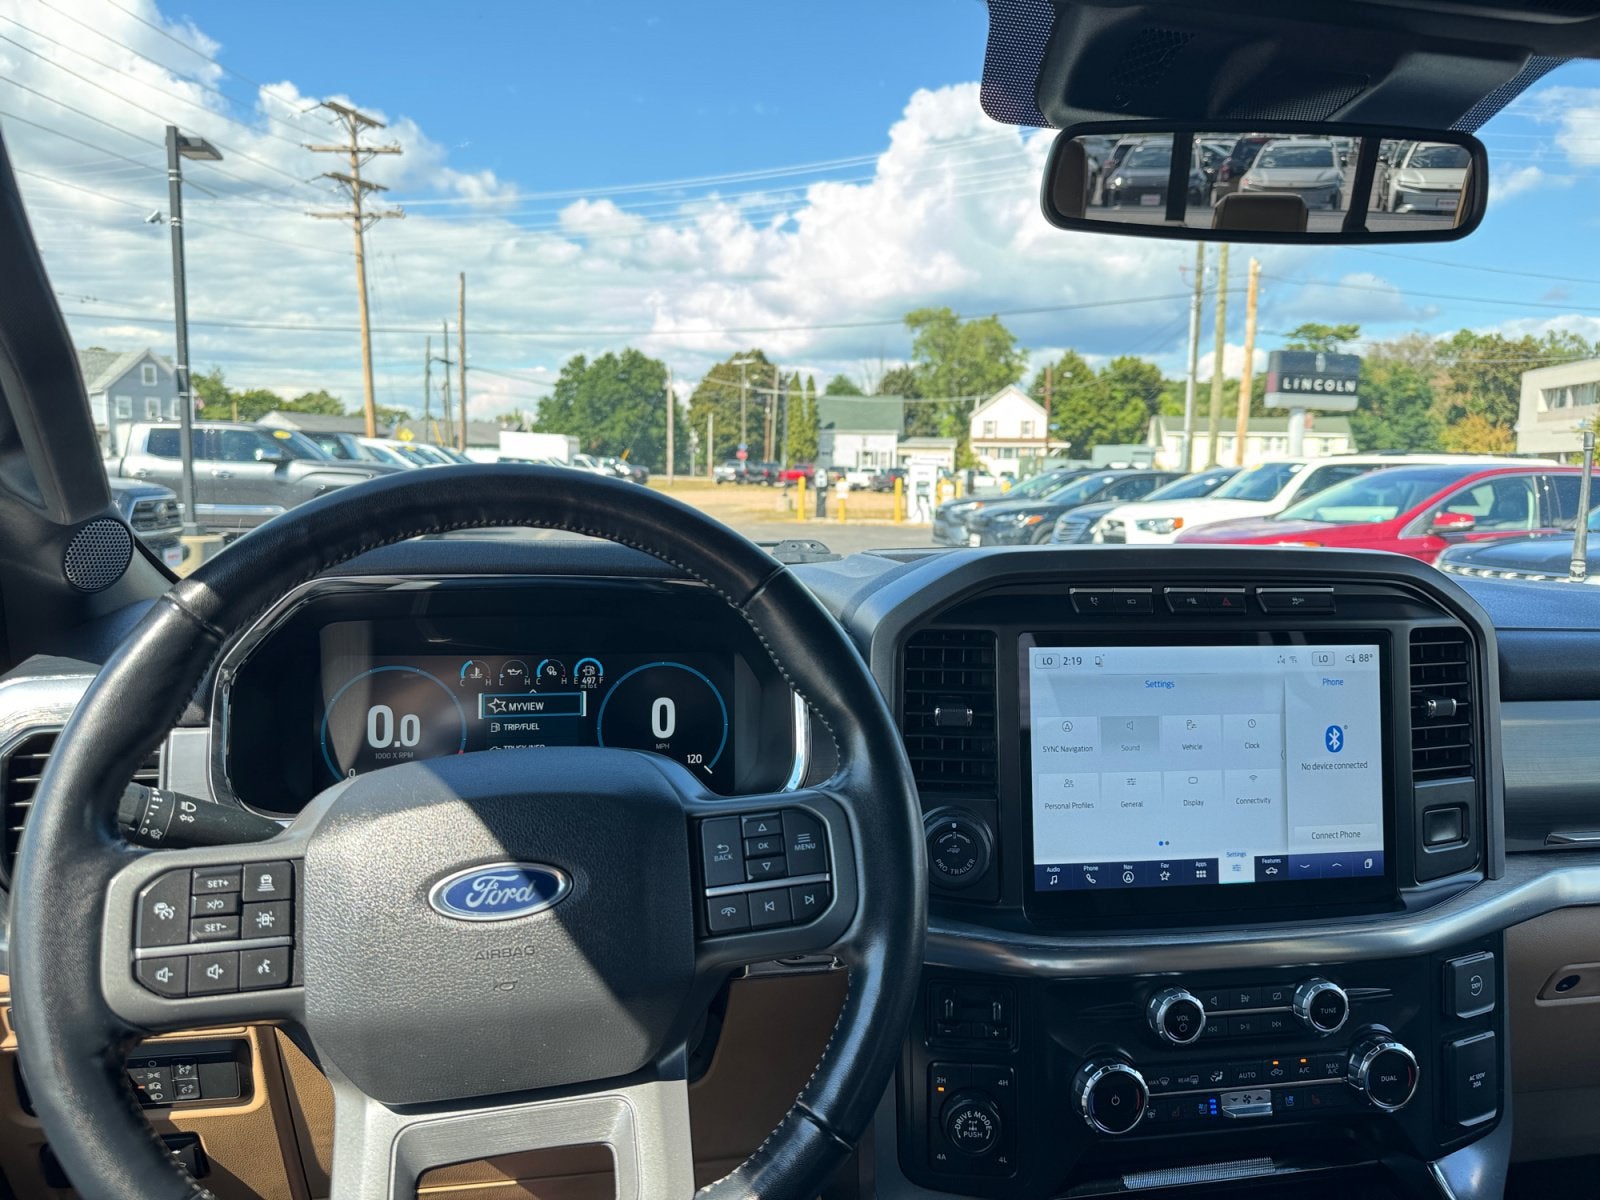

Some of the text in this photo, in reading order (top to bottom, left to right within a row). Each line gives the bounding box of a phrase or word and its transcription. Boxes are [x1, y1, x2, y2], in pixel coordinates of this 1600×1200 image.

[1283, 377, 1356, 392] LINCOLN
[1042, 657, 1053, 665] LO
[1063, 656, 1082, 665] 2:19
[1318, 655, 1328, 663] LO
[1145, 680, 1175, 689] Settings
[1322, 678, 1344, 686] Phone
[508, 702, 544, 711] MYVIEW
[652, 697, 676, 739] 0
[367, 705, 421, 749] 0.0
[503, 723, 540, 731] TRIP/FUEL
[1043, 745, 1094, 753] SYNC Navigation
[1182, 743, 1203, 751] Vehicle
[687, 754, 702, 764] 120
[1312, 762, 1333, 770] device
[1334, 761, 1368, 770] connected
[1183, 799, 1204, 807] Display
[1236, 797, 1271, 805] Connectivity
[1045, 802, 1070, 810] Personal
[1311, 830, 1361, 840] Connect Phone
[794, 843, 816, 851] MENU
[714, 854, 733, 862] BACK
[936, 858, 976, 875] PRO TRAILER
[466, 874, 536, 908] Ford
[474, 945, 535, 961] AIRBAG
[1238, 1071, 1257, 1079] AUTO
[936, 1076, 946, 1084] 2H
[954, 1111, 993, 1130] DRIVE MODE
